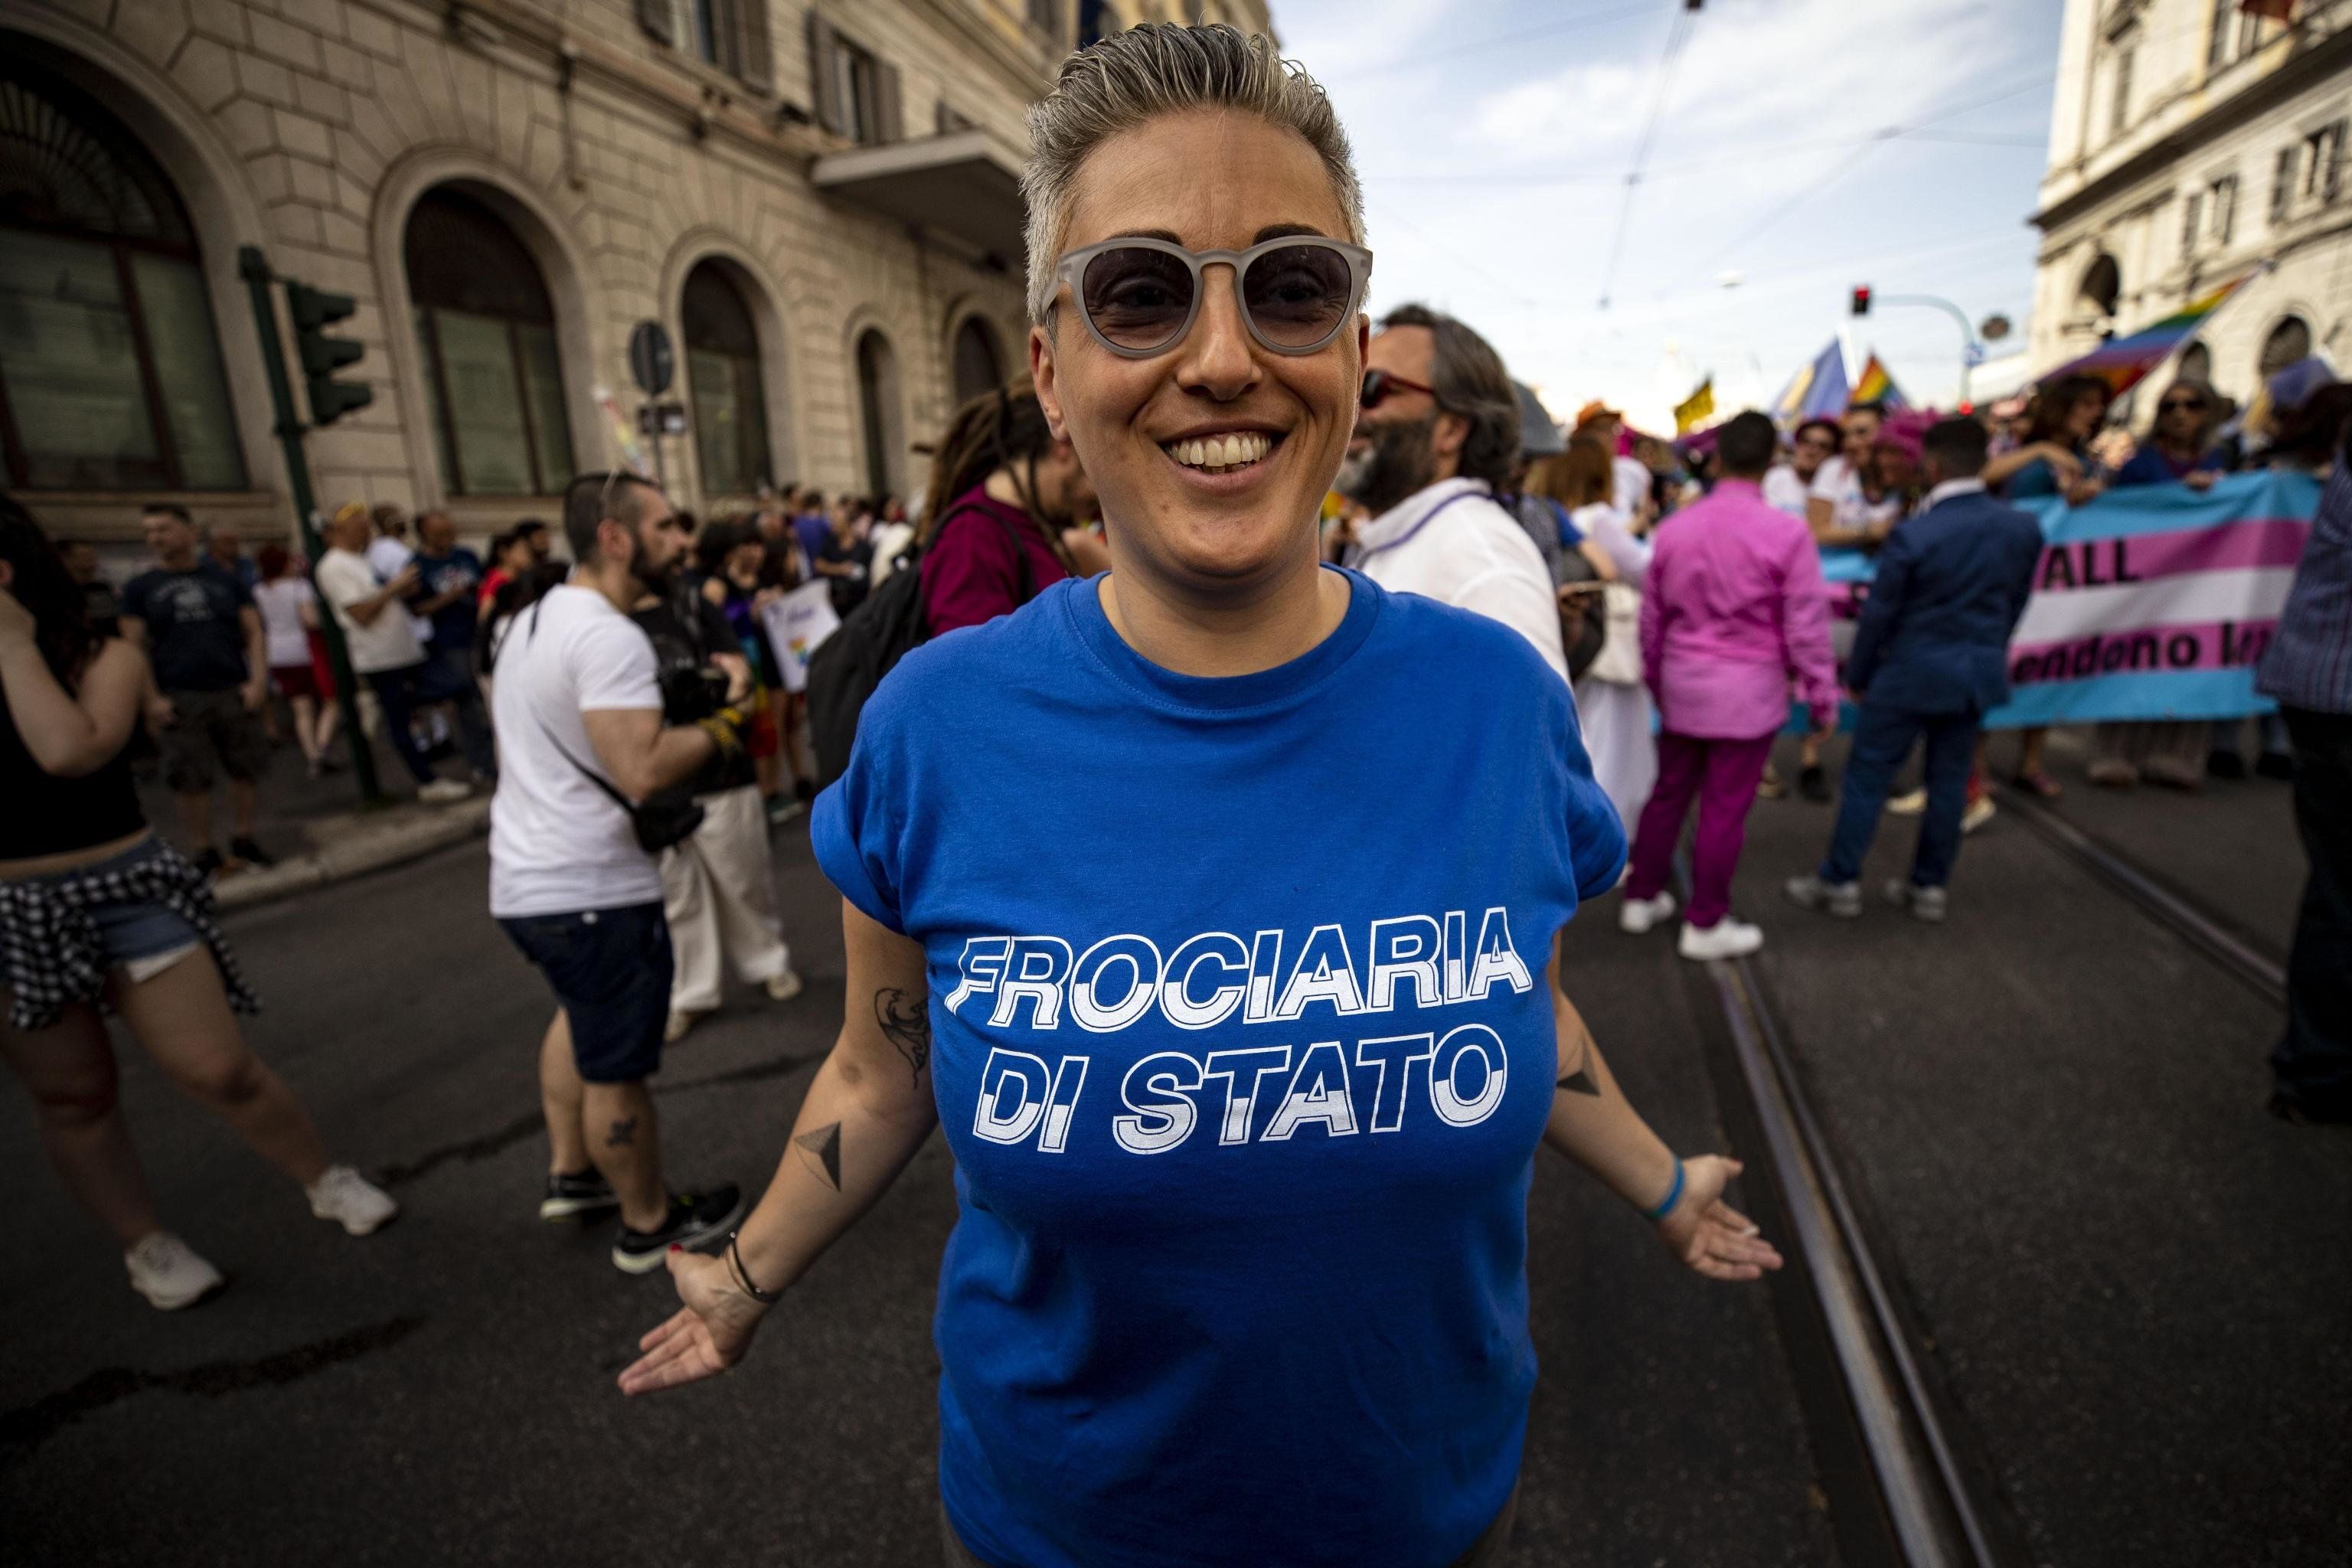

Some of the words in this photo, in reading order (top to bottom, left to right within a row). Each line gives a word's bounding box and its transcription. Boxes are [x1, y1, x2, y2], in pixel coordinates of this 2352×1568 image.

[2043, 539, 2140, 589] ALL
[944, 907, 1533, 1033] FROCIARIA
[973, 1047, 1089, 1154] DI
[1112, 1024, 1508, 1155] STATO
